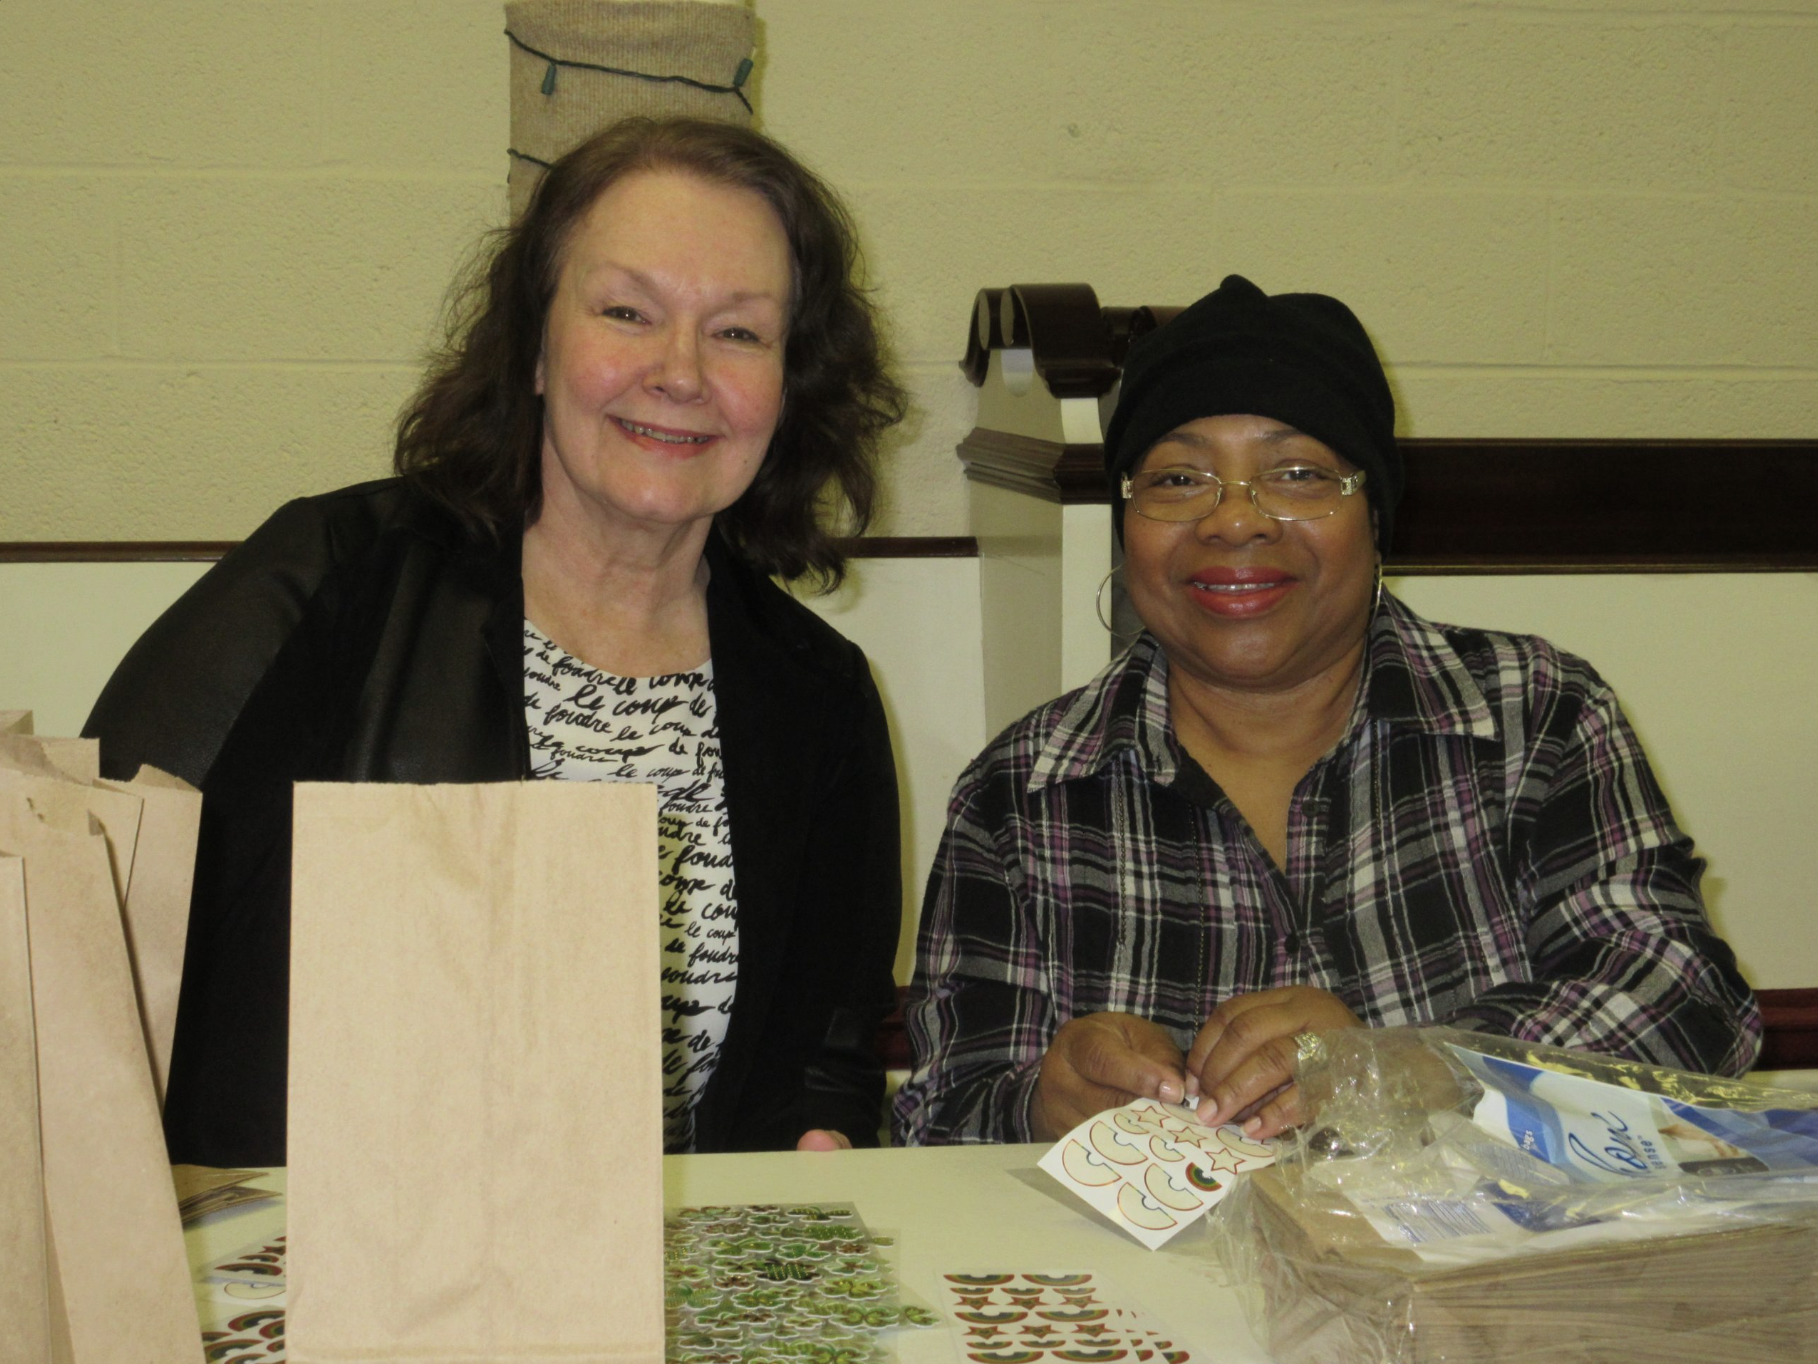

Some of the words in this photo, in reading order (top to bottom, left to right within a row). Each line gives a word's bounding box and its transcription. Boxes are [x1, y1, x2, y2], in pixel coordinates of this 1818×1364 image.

[562, 684, 606, 711] le
[612, 695, 689, 725] coup
[690, 692, 713, 718] de
[543, 703, 613, 734] foudre
[609, 726, 644, 742] le
[648, 721, 698, 737] coup
[575, 744, 665, 764] coup
[668, 736, 688, 755] de
[606, 764, 638, 778] le
[646, 767, 691, 784] coup
[692, 765, 706, 776] de
[658, 816, 693, 833] oup
[696, 817, 710, 828] de
[663, 888, 693, 916] le
[684, 921, 701, 938] le
[706, 928, 736, 946] coup
